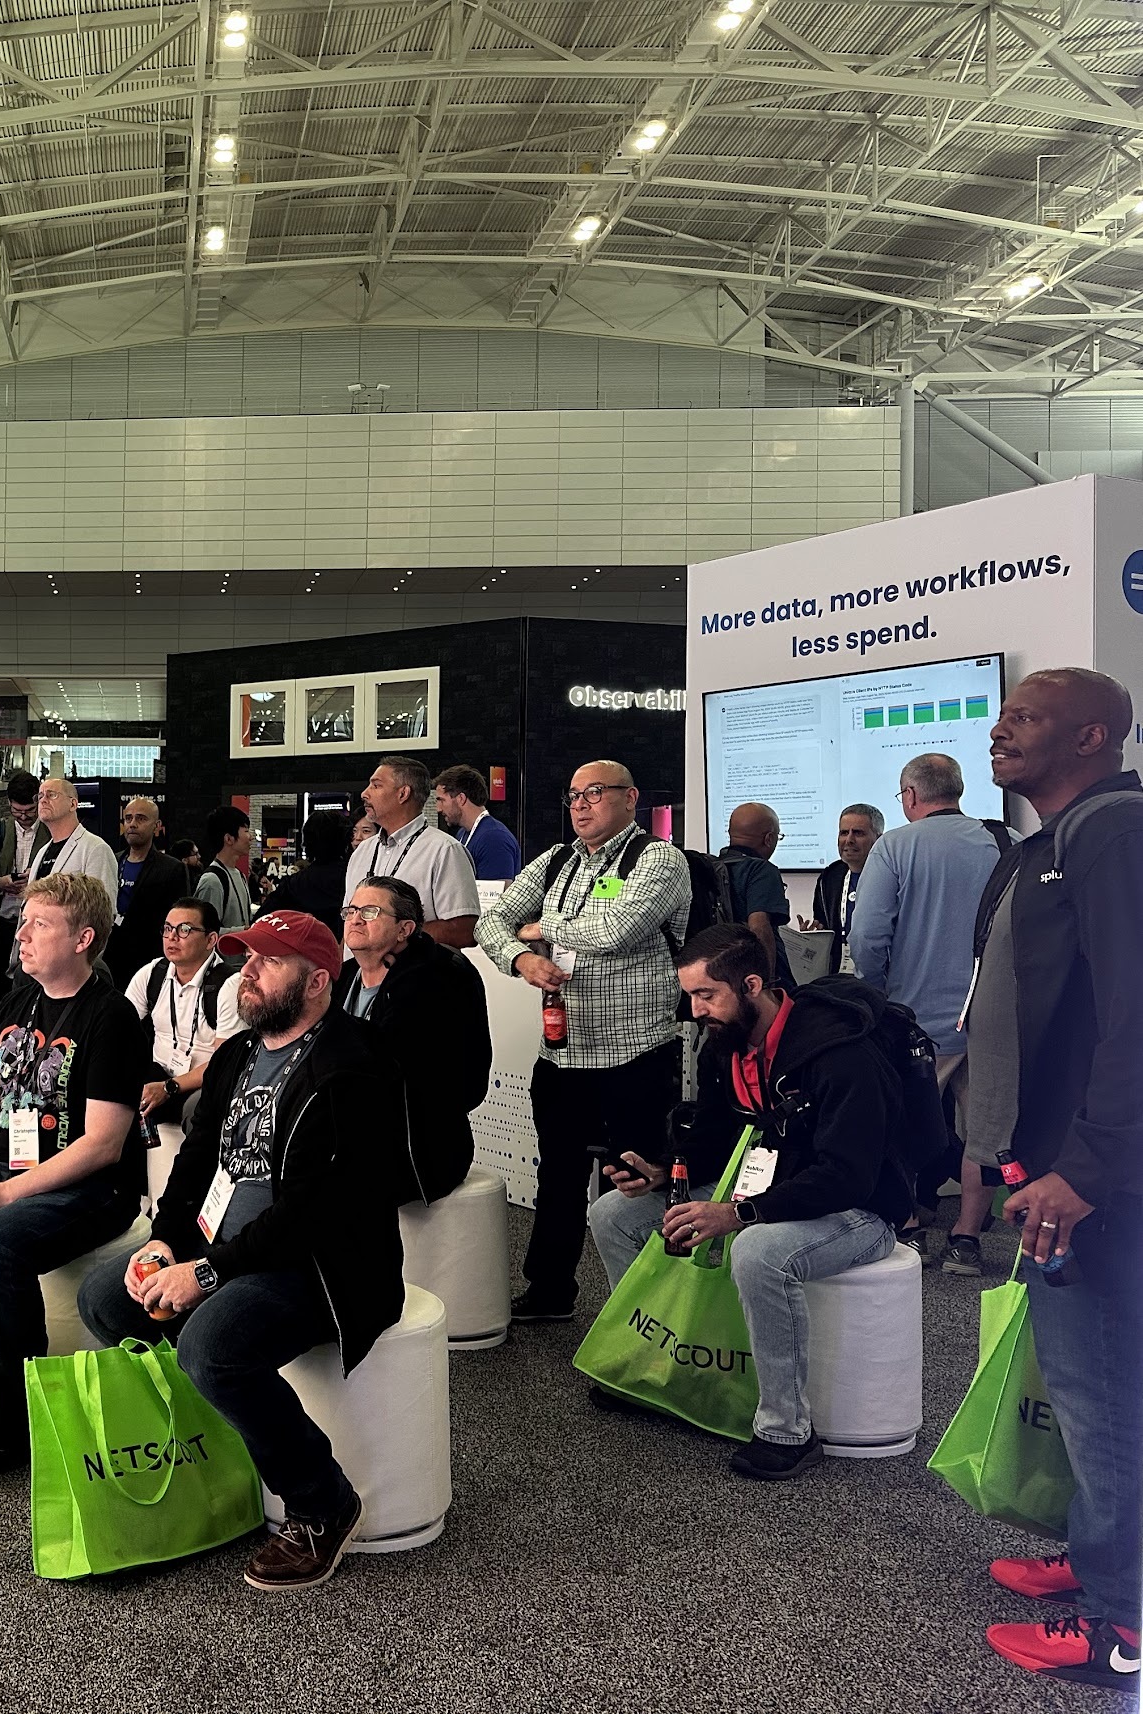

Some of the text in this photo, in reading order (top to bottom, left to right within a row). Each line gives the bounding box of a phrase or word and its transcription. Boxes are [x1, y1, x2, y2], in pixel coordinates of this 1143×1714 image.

[701, 554, 1071, 635] More data, more workflows,
[792, 615, 937, 658] less spend.
[1040, 869, 1063, 883] splu
[57, 1039, 78, 1087] AROUND
[57, 1111, 70, 1150] WORLD
